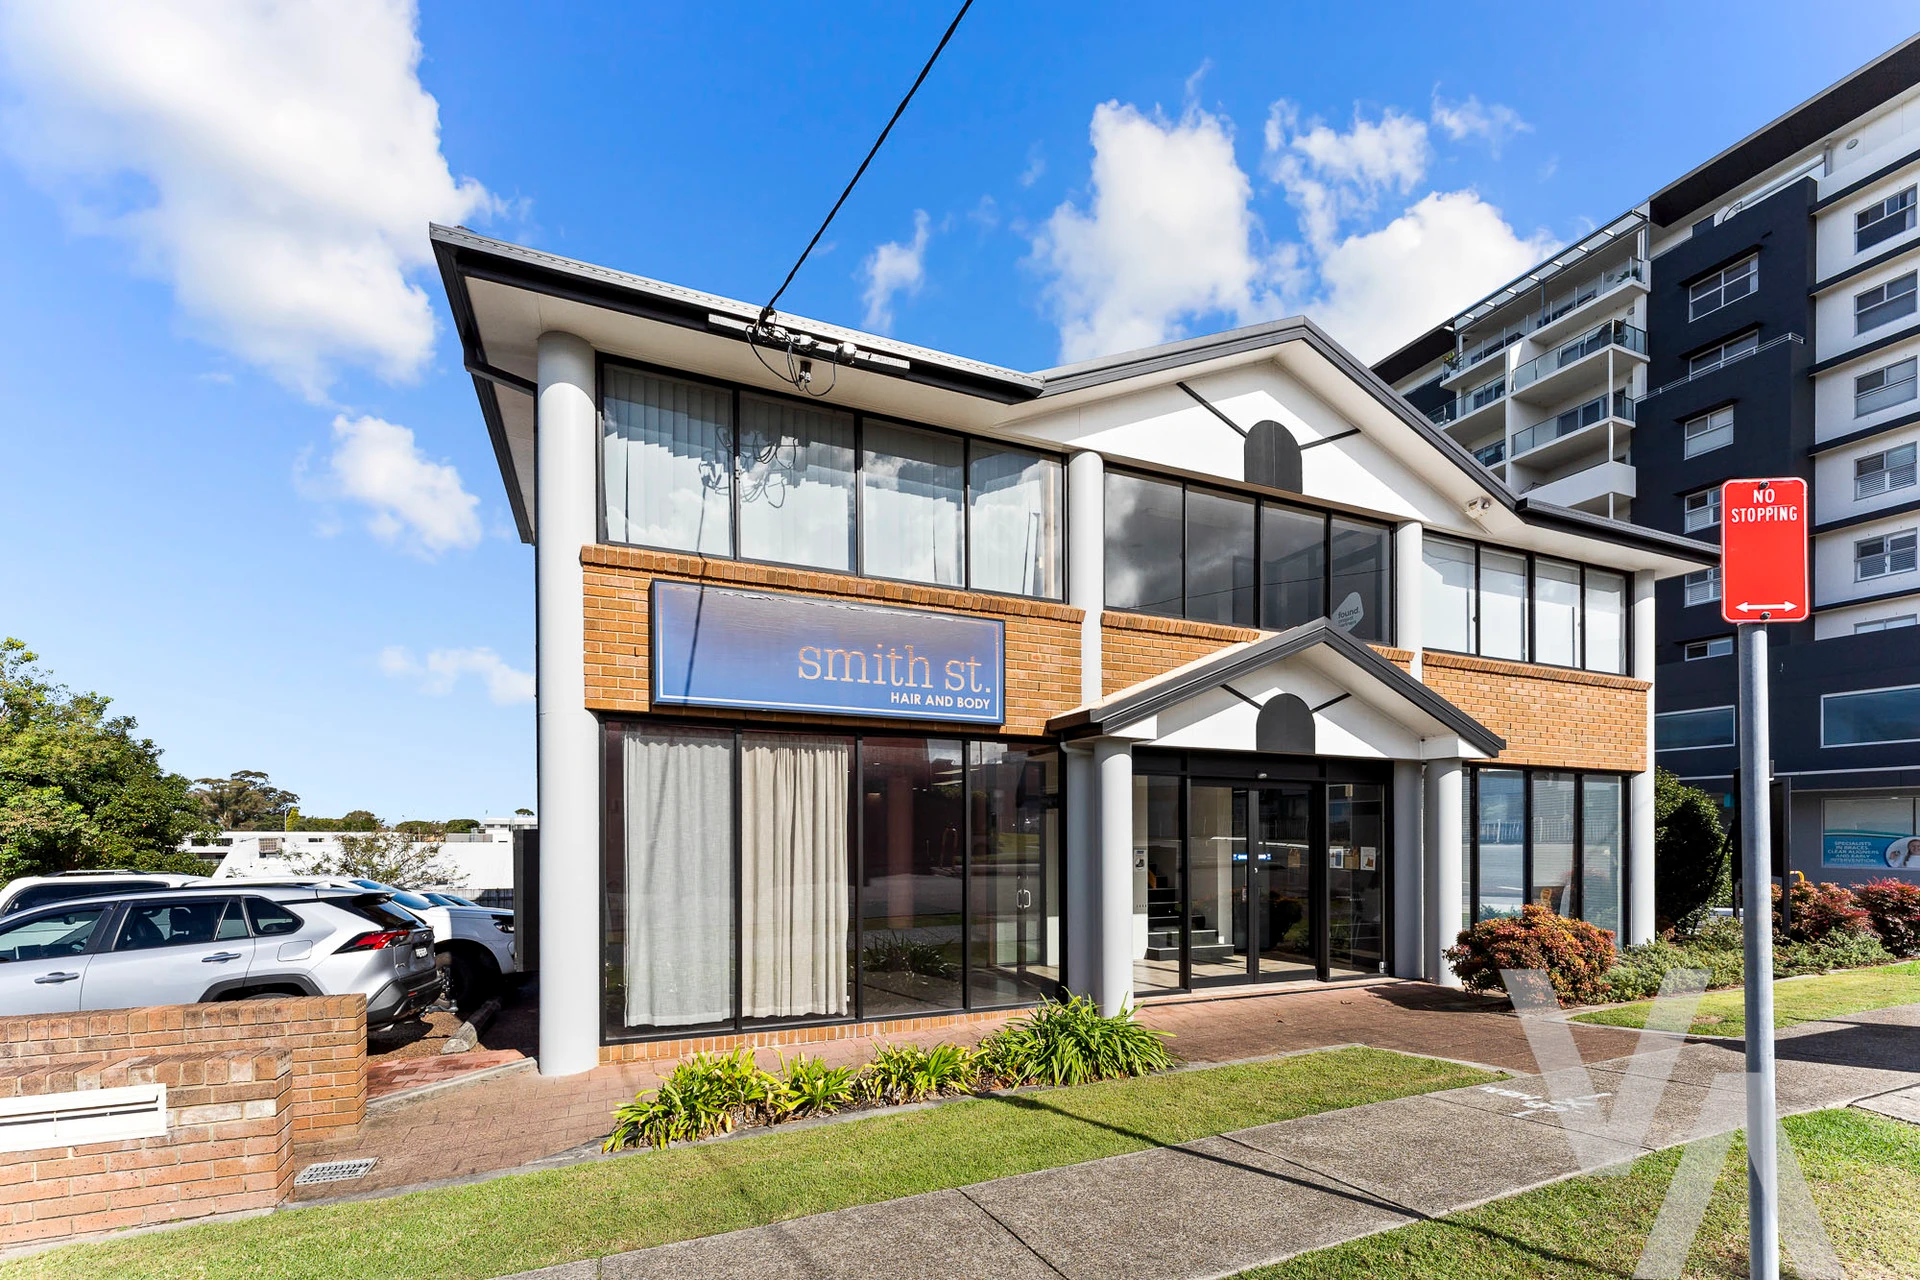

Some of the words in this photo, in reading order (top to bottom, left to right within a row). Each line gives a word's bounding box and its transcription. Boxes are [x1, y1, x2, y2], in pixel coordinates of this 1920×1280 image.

[1753, 488, 1775, 504] NO
[1731, 505, 1798, 523] STOPPING
[798, 643, 934, 689] smith
[945, 655, 991, 694] st.
[891, 692, 921, 705] HAIR
[925, 695, 954, 708] AND
[957, 697, 991, 710] BODY
